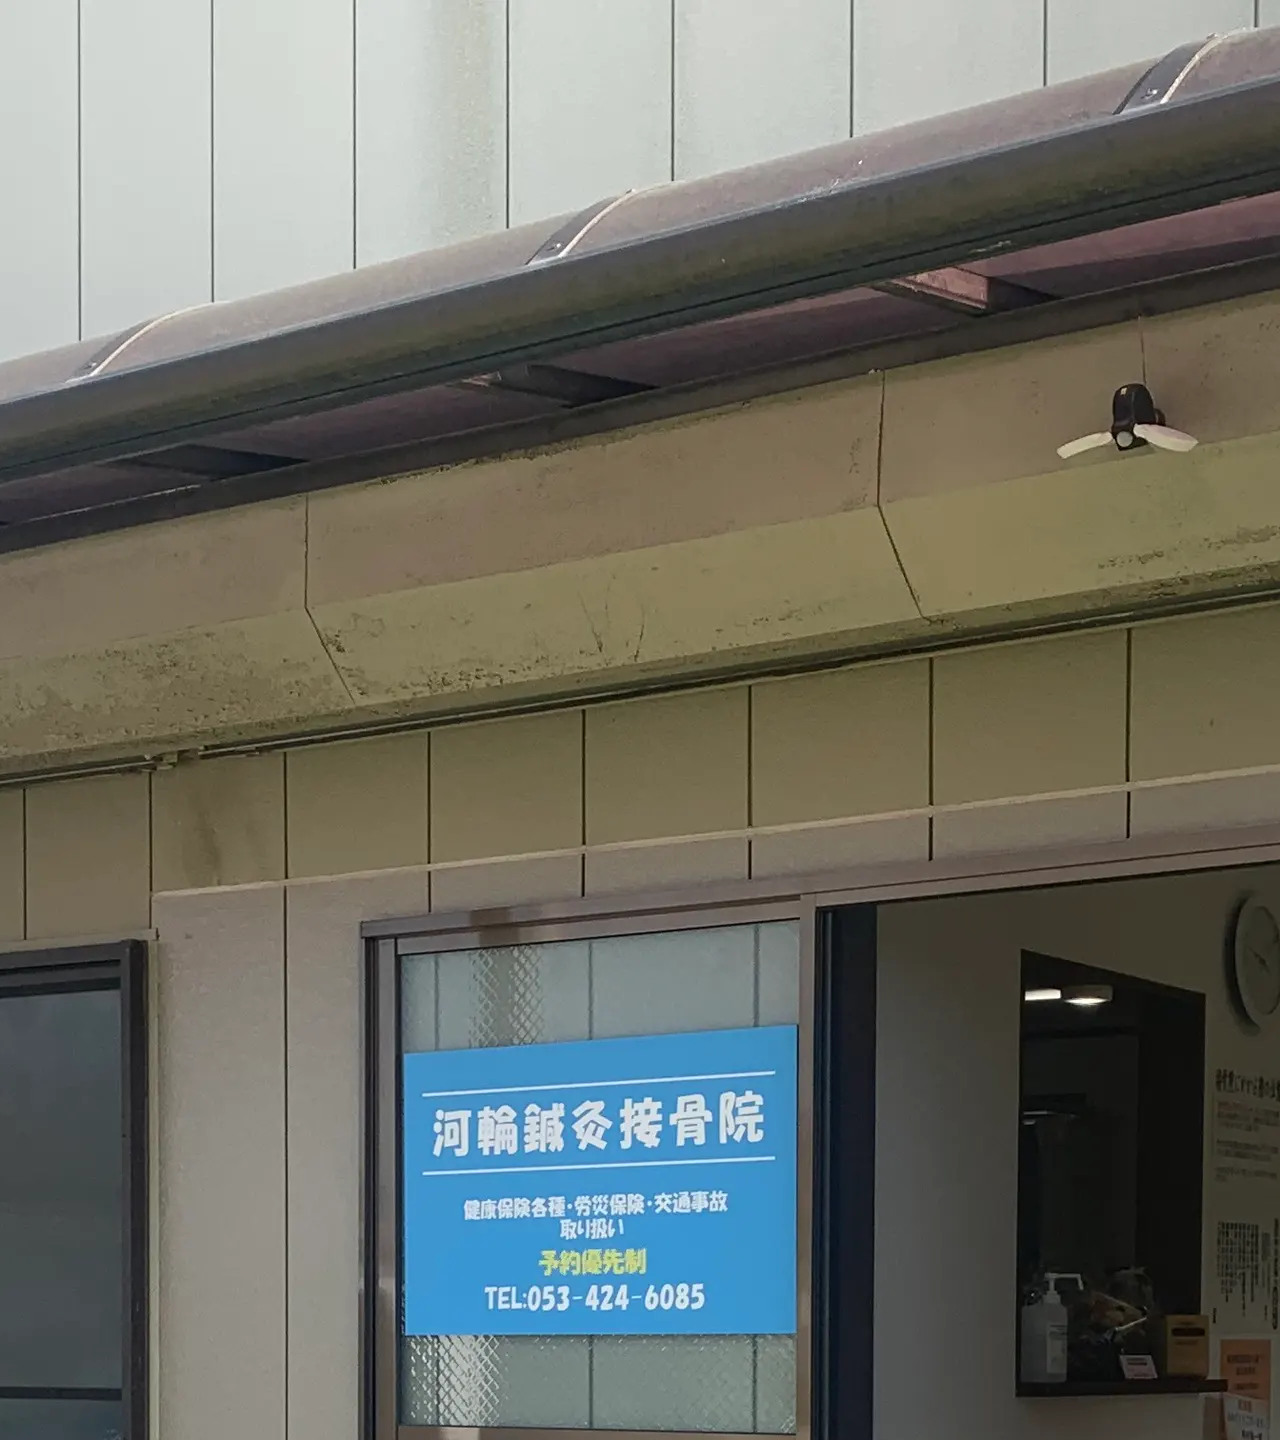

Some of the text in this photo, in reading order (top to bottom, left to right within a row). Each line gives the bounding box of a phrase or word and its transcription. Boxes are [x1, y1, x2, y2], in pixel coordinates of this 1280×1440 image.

[432, 1089, 765, 1158] 河輪鍼灸接骨院
[559, 1218, 625, 1241] 取り扱い
[538, 1247, 647, 1277] 予約優先制
